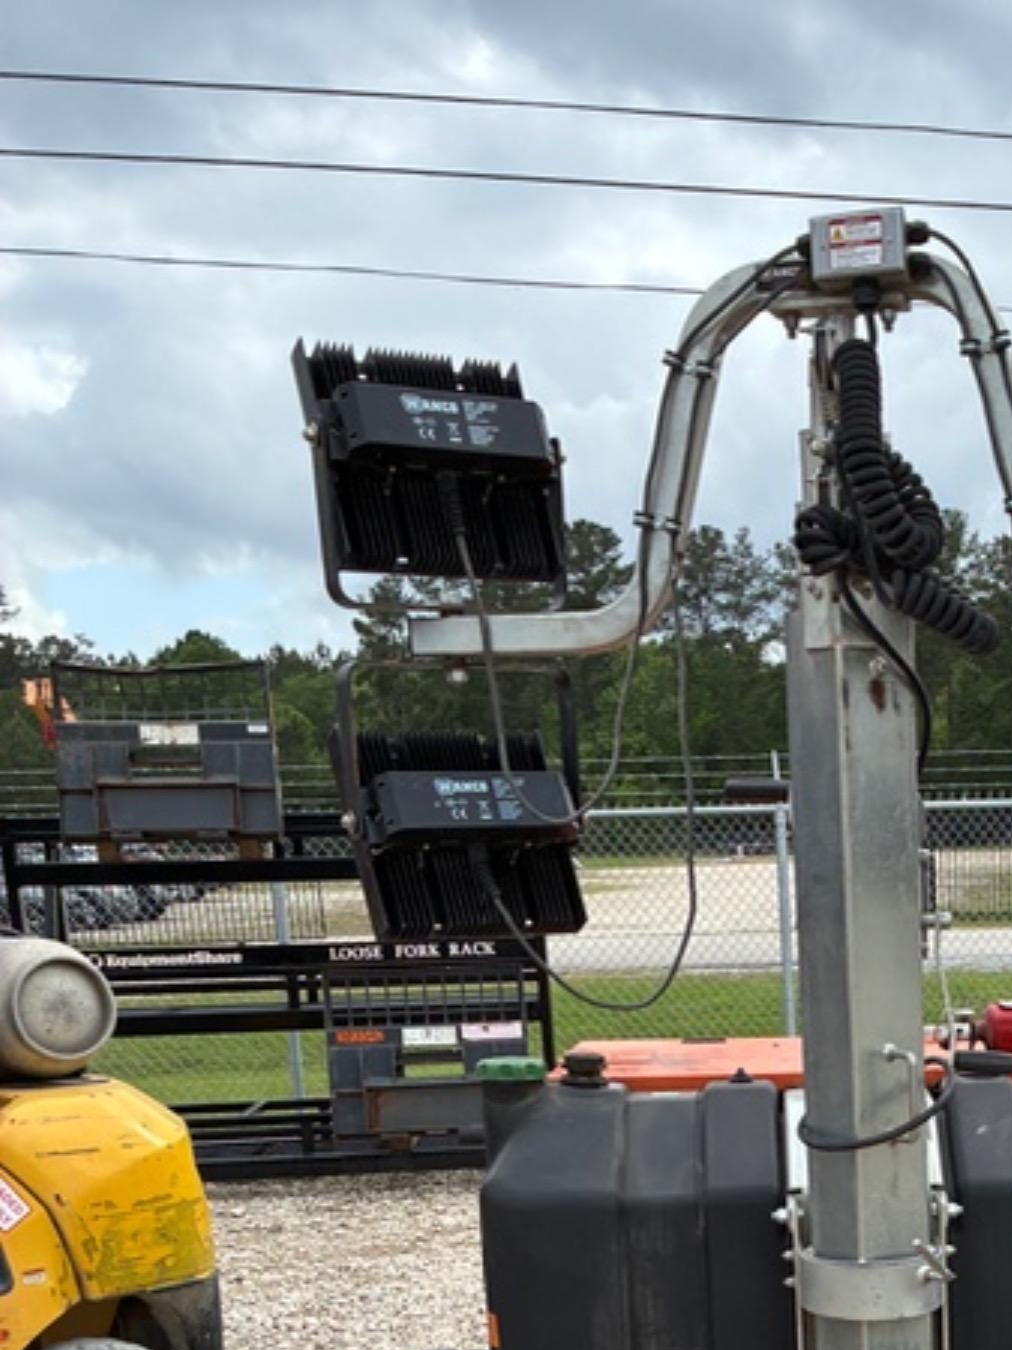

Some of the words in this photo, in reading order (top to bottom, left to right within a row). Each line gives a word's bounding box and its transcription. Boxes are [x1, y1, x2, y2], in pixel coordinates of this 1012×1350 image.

[106, 950, 243, 969] EquipmentShare
[328, 944, 384, 961] LOOSE
[395, 943, 441, 959] FORK
[449, 941, 496, 957] RACK
